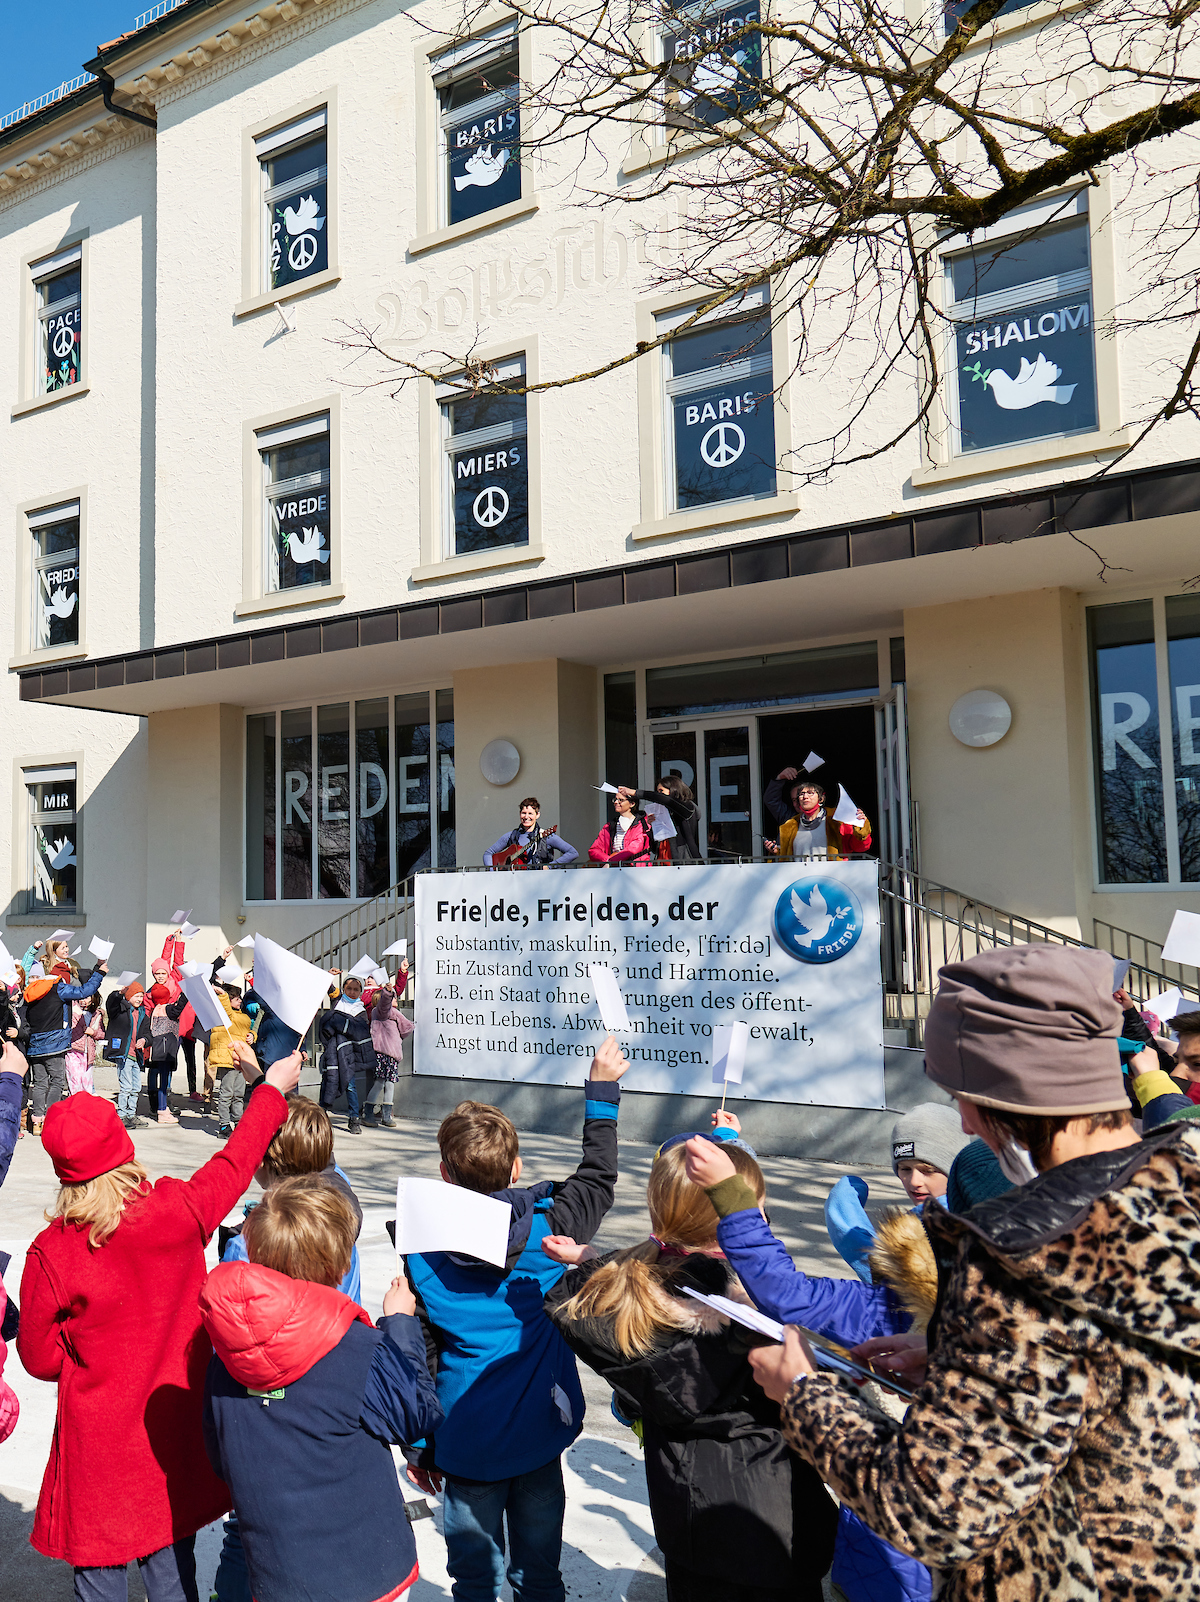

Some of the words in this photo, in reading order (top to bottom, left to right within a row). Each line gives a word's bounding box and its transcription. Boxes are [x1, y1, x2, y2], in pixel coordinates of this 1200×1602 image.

[48, 308, 80, 333] PACE
[966, 302, 1090, 355] SHALOM
[457, 446, 521, 479] MIERS
[276, 494, 327, 520] VREDE
[47, 566, 79, 585] FRIEDE
[43, 793, 69, 809] MIR
[668, 895, 719, 921] der
[435, 934, 524, 955] Substantiv,
[529, 933, 618, 956] maskulin,
[623, 934, 691, 958] Friede,
[817, 923, 856, 955] FRIEDE
[435, 959, 462, 977] Ein
[466, 960, 533, 977] Zustand
[538, 964, 569, 978] von
[626, 962, 663, 980] und
[669, 963, 780, 983] Harmonie.
[434, 984, 464, 1000] z.B.
[469, 984, 495, 1001] ein
[499, 985, 542, 1003] Staat
[545, 987, 590, 1004] ohne
[596, 988, 695, 1013] rungen
[701, 990, 736, 1010] des
[741, 991, 813, 1012] öffent-
[435, 1007, 486, 1026] lichen
[490, 1010, 557, 1029] Lebens.
[690, 1023, 725, 1037] vo
[738, 1020, 815, 1047] ewalt,
[435, 1033, 482, 1054] Angst
[486, 1036, 518, 1053] und
[523, 1038, 595, 1058] anderen
[620, 1042, 710, 1068] örungen.
